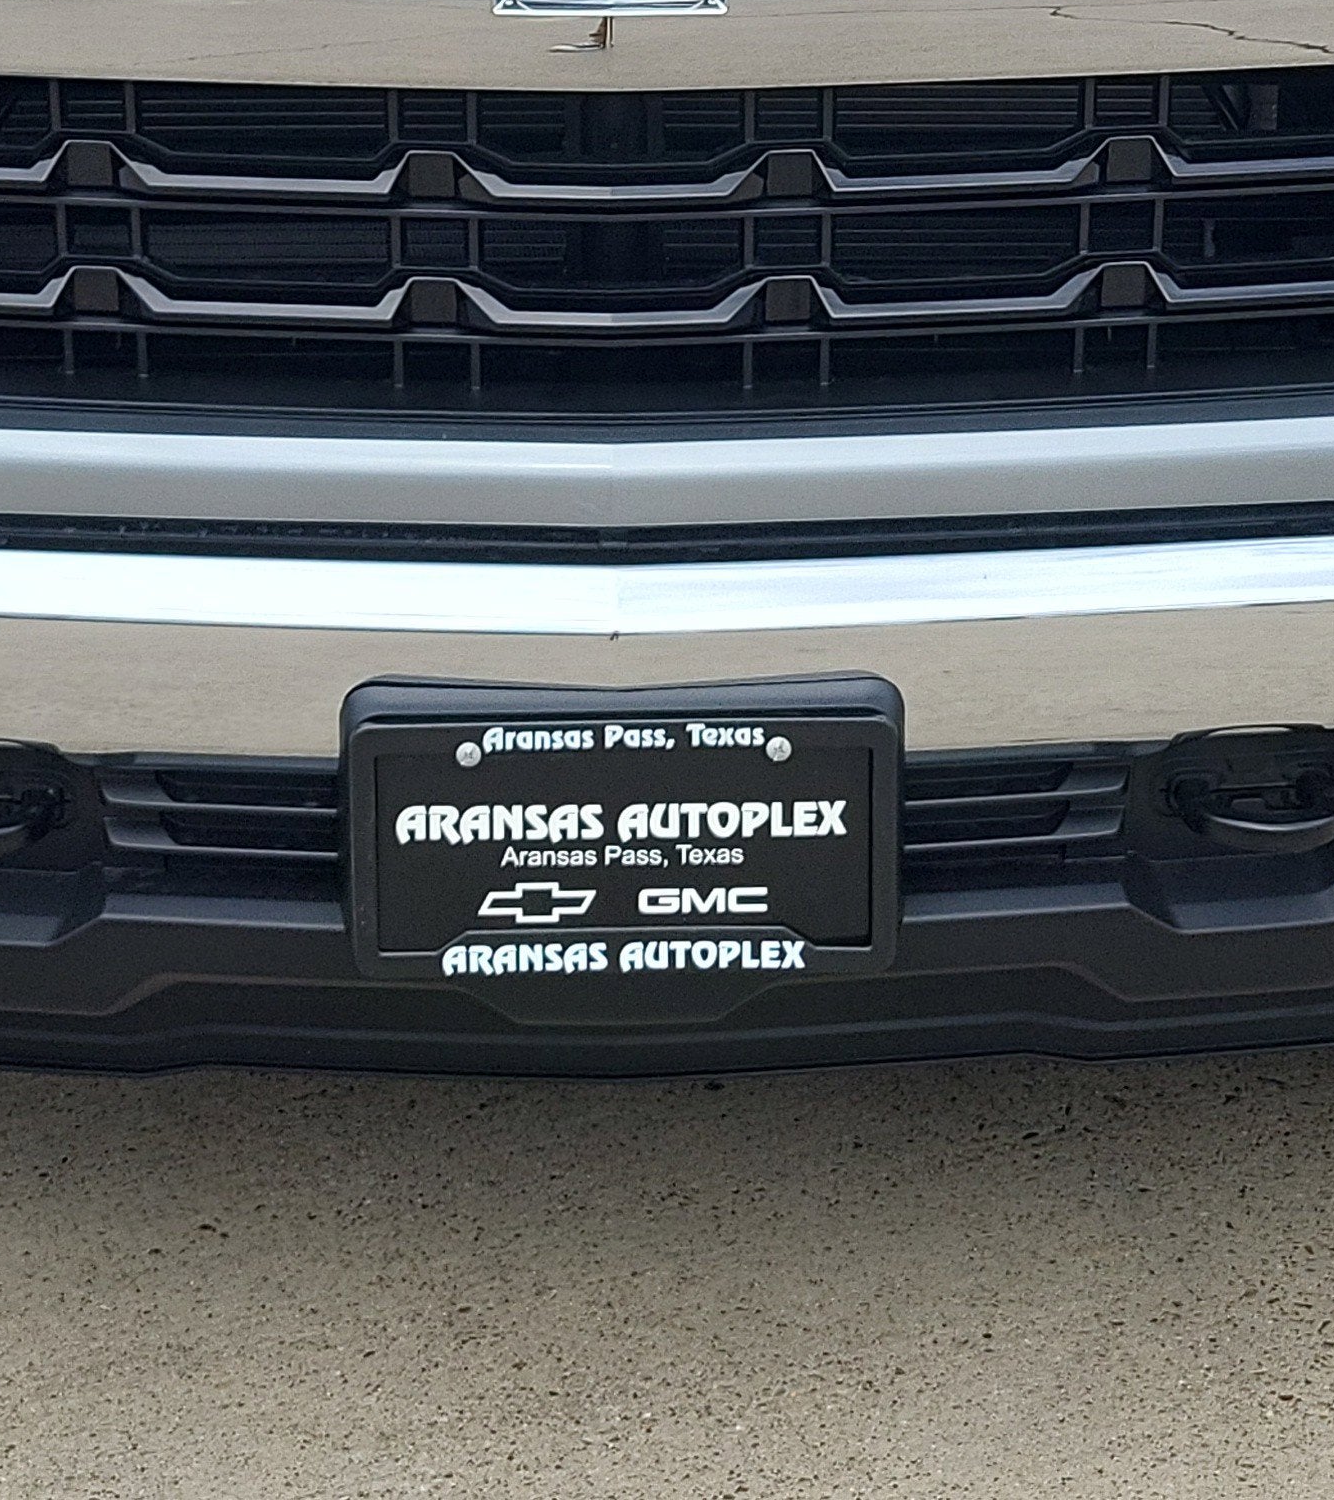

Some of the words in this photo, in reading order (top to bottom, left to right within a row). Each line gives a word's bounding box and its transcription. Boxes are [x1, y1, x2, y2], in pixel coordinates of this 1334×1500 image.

[483, 725, 594, 753] Aransas
[604, 724, 675, 749] Pass,
[686, 723, 765, 746] Texas
[396, 804, 604, 845] ARANSAS
[618, 800, 847, 842] AUTOPLEX
[501, 846, 597, 867] Aransas
[605, 845, 668, 867] Pass,
[676, 844, 744, 865] Texas
[638, 887, 768, 914] GMC
[442, 943, 608, 976] ARANSAS
[620, 941, 805, 973] AUTOPLEX
